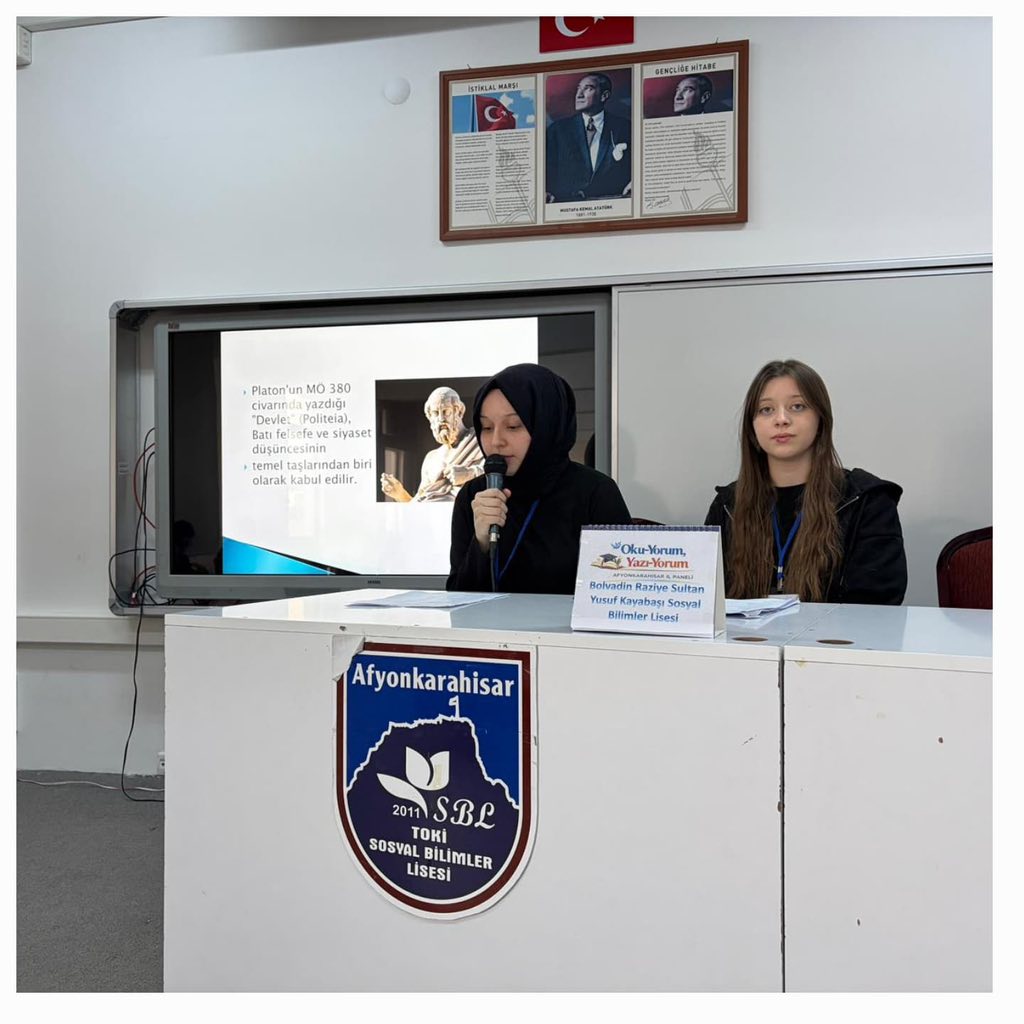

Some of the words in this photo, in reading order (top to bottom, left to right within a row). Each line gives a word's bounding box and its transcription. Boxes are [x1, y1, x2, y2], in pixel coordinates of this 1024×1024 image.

[655, 64, 689, 75] GENÇLİĞE
[691, 62, 716, 72] HİTABE
[468, 84, 496, 93] İSTİKLAL
[498, 82, 519, 91] MARŞI
[251, 384, 303, 396] Platon'un
[306, 382, 326, 394] MÖ
[329, 383, 351, 394] 380
[251, 399, 303, 410] civarında
[305, 398, 346, 412] yazdığı
[299, 413, 352, 426] (Politeia),
[252, 429, 273, 440] Batı
[316, 430, 329, 439] ve
[332, 428, 372, 441] siyaset
[252, 443, 326, 456] düşüncesinin
[252, 460, 283, 471] temel
[287, 459, 350, 472] taşlarından
[353, 458, 372, 470] biri
[252, 475, 287, 486] olarak
[291, 474, 321, 485] kabul
[325, 473, 358, 485] edilir.
[621, 543, 687, 557] Oku-Yorum,
[626, 557, 689, 569] Yazı-Yorum
[589, 581, 632, 591] Bolvadin
[636, 582, 669, 593] Raziye
[671, 583, 705, 594] Sultan
[590, 594, 618, 605] Yusuf
[620, 597, 665, 609] Kayabaşı
[668, 599, 701, 610] Sosyal
[608, 610, 648, 621] Bilimler
[651, 612, 679, 623] Lisesi
[351, 662, 515, 697] Afyonkarahisar
[392, 804, 420, 819] 2011
[432, 795, 495, 830] SBL
[411, 826, 447, 844] TOKİ
[369, 837, 420, 858] SOSYAL
[424, 847, 493, 870] BİLİMLER
[407, 861, 452, 882] LİSESİ
